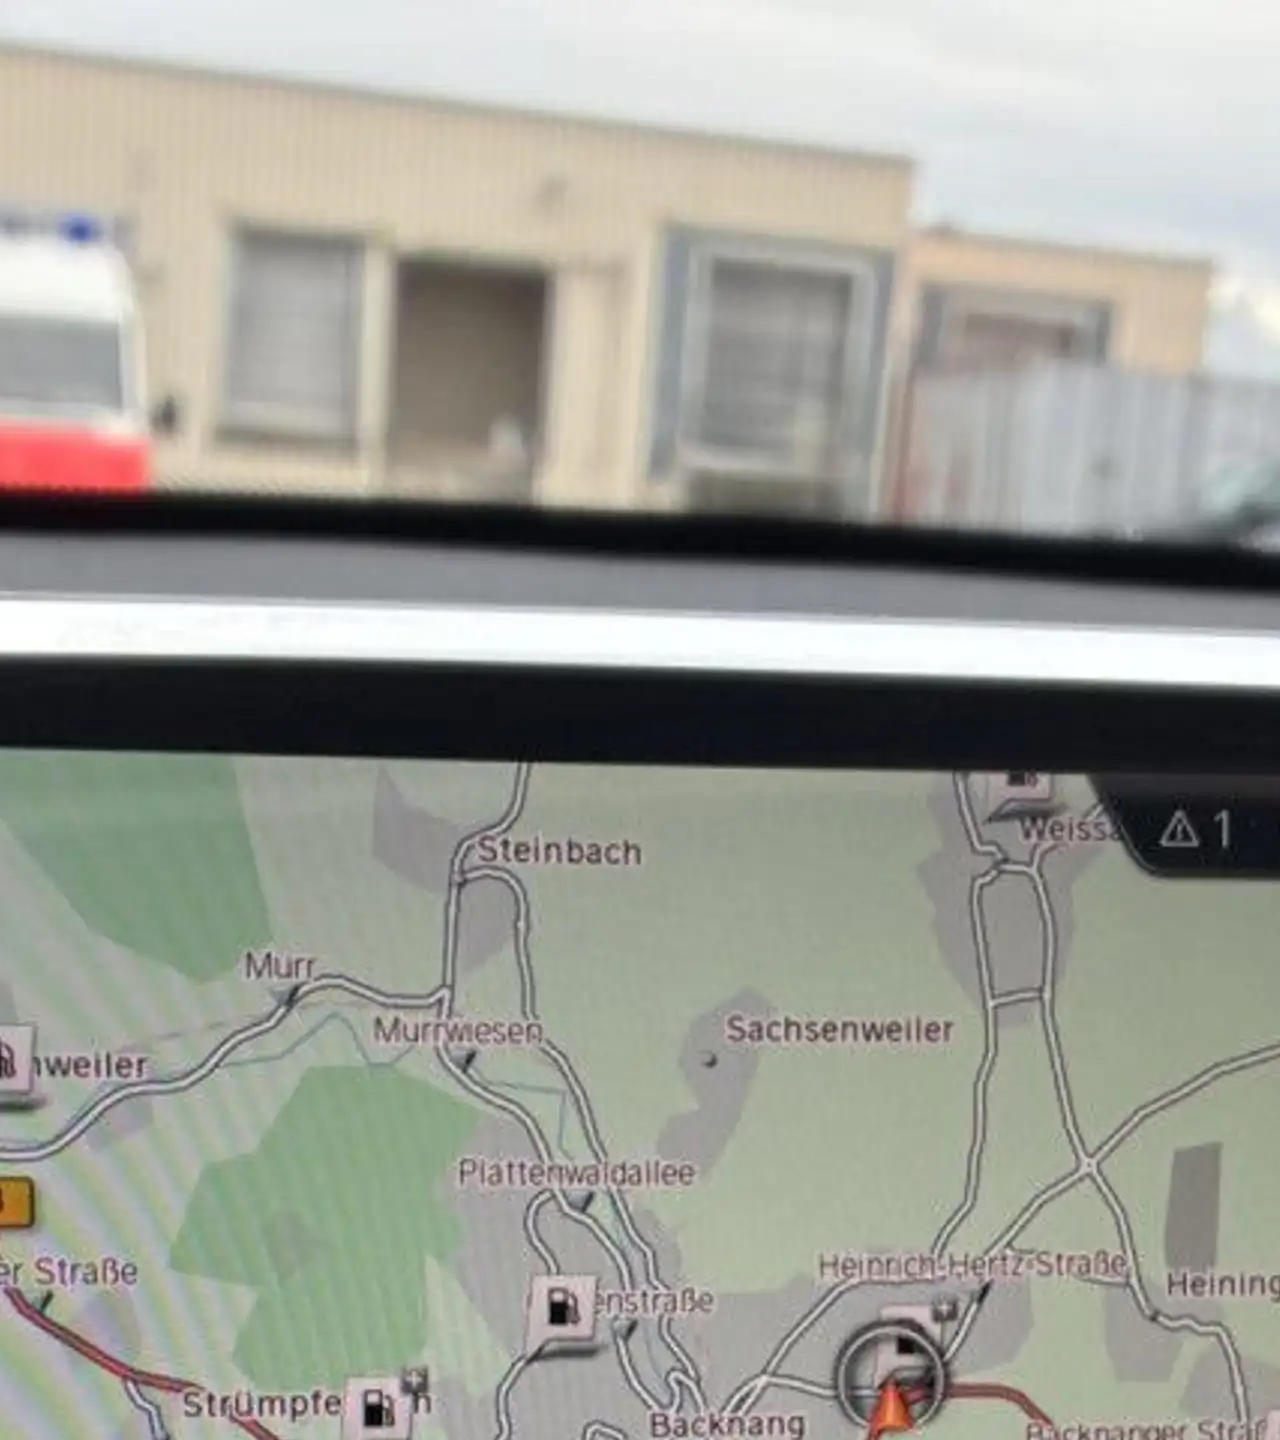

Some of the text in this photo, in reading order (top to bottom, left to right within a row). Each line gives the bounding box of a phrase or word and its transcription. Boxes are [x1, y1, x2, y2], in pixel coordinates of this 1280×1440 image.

[1213, 808, 1232, 848] 1
[478, 836, 643, 865] Steinbach
[245, 952, 318, 979] Murr
[375, 1016, 543, 1044] Murrwiesen
[727, 1016, 955, 1043] Sachsenweiler
[459, 1158, 696, 1187] Plattenwaldallee
[36, 1256, 139, 1286] Straße
